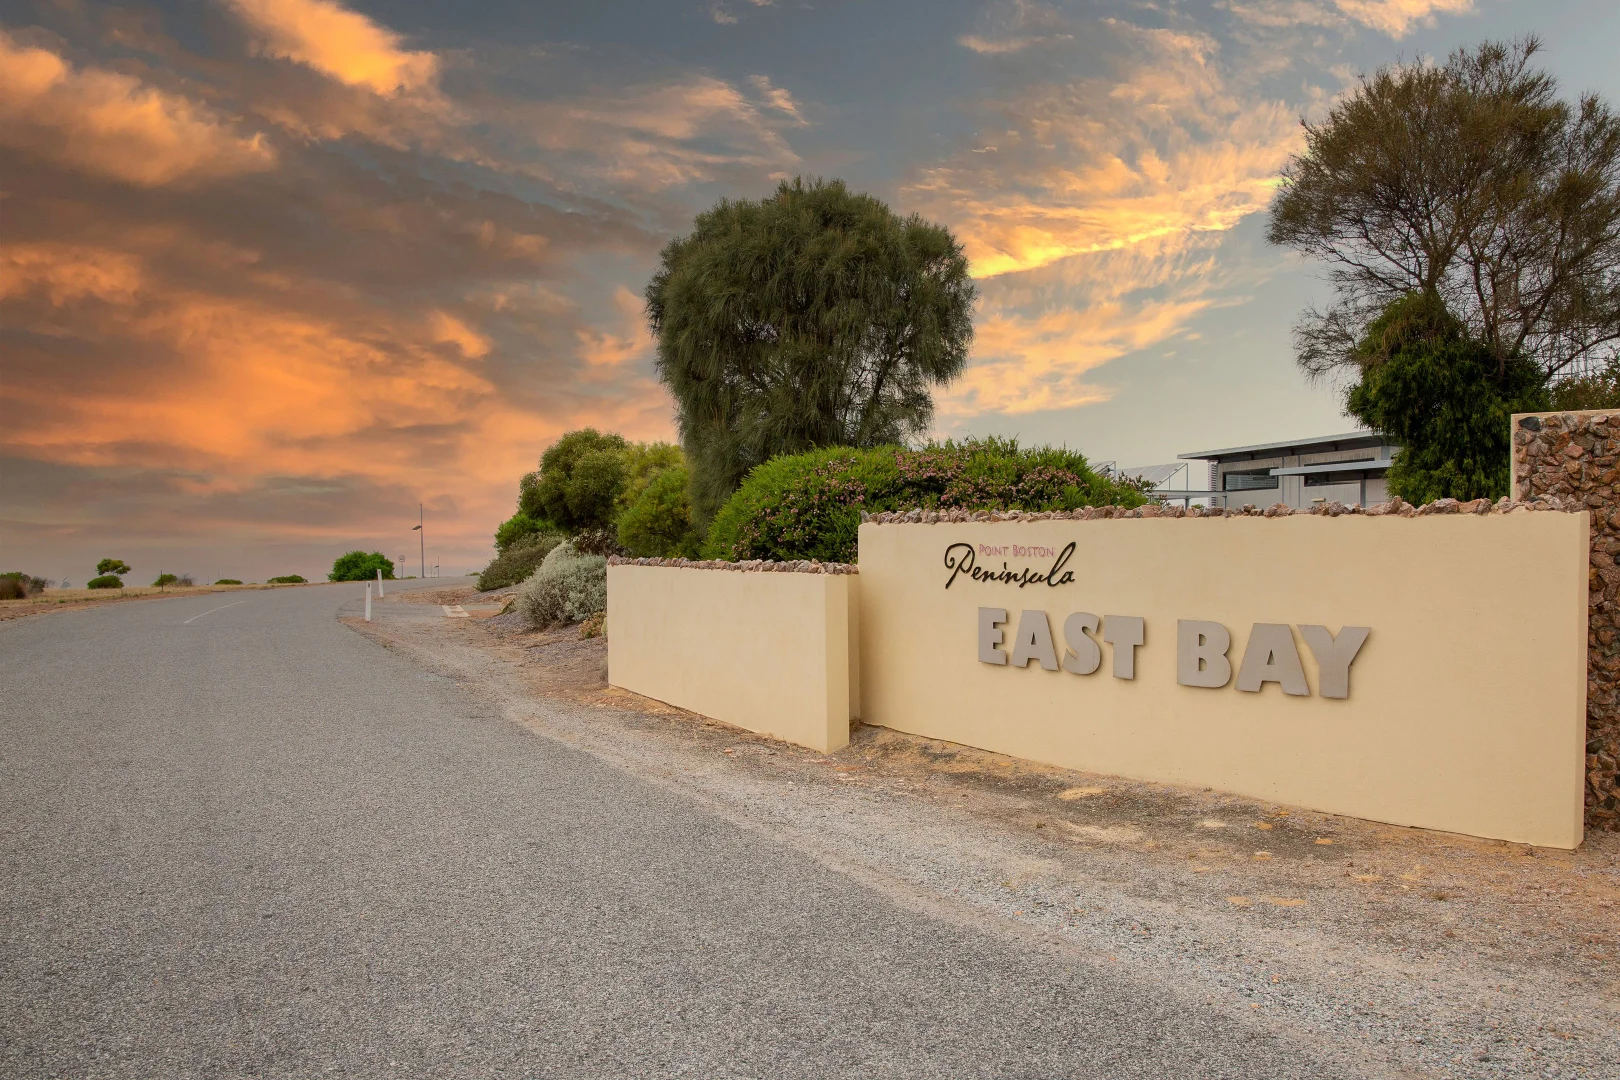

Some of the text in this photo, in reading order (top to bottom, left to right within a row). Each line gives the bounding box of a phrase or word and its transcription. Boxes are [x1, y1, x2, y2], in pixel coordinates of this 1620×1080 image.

[944, 541, 1076, 589] Peninsula
[979, 544, 1055, 557] POINT BOSTON
[977, 607, 1373, 700] EAST BAY
